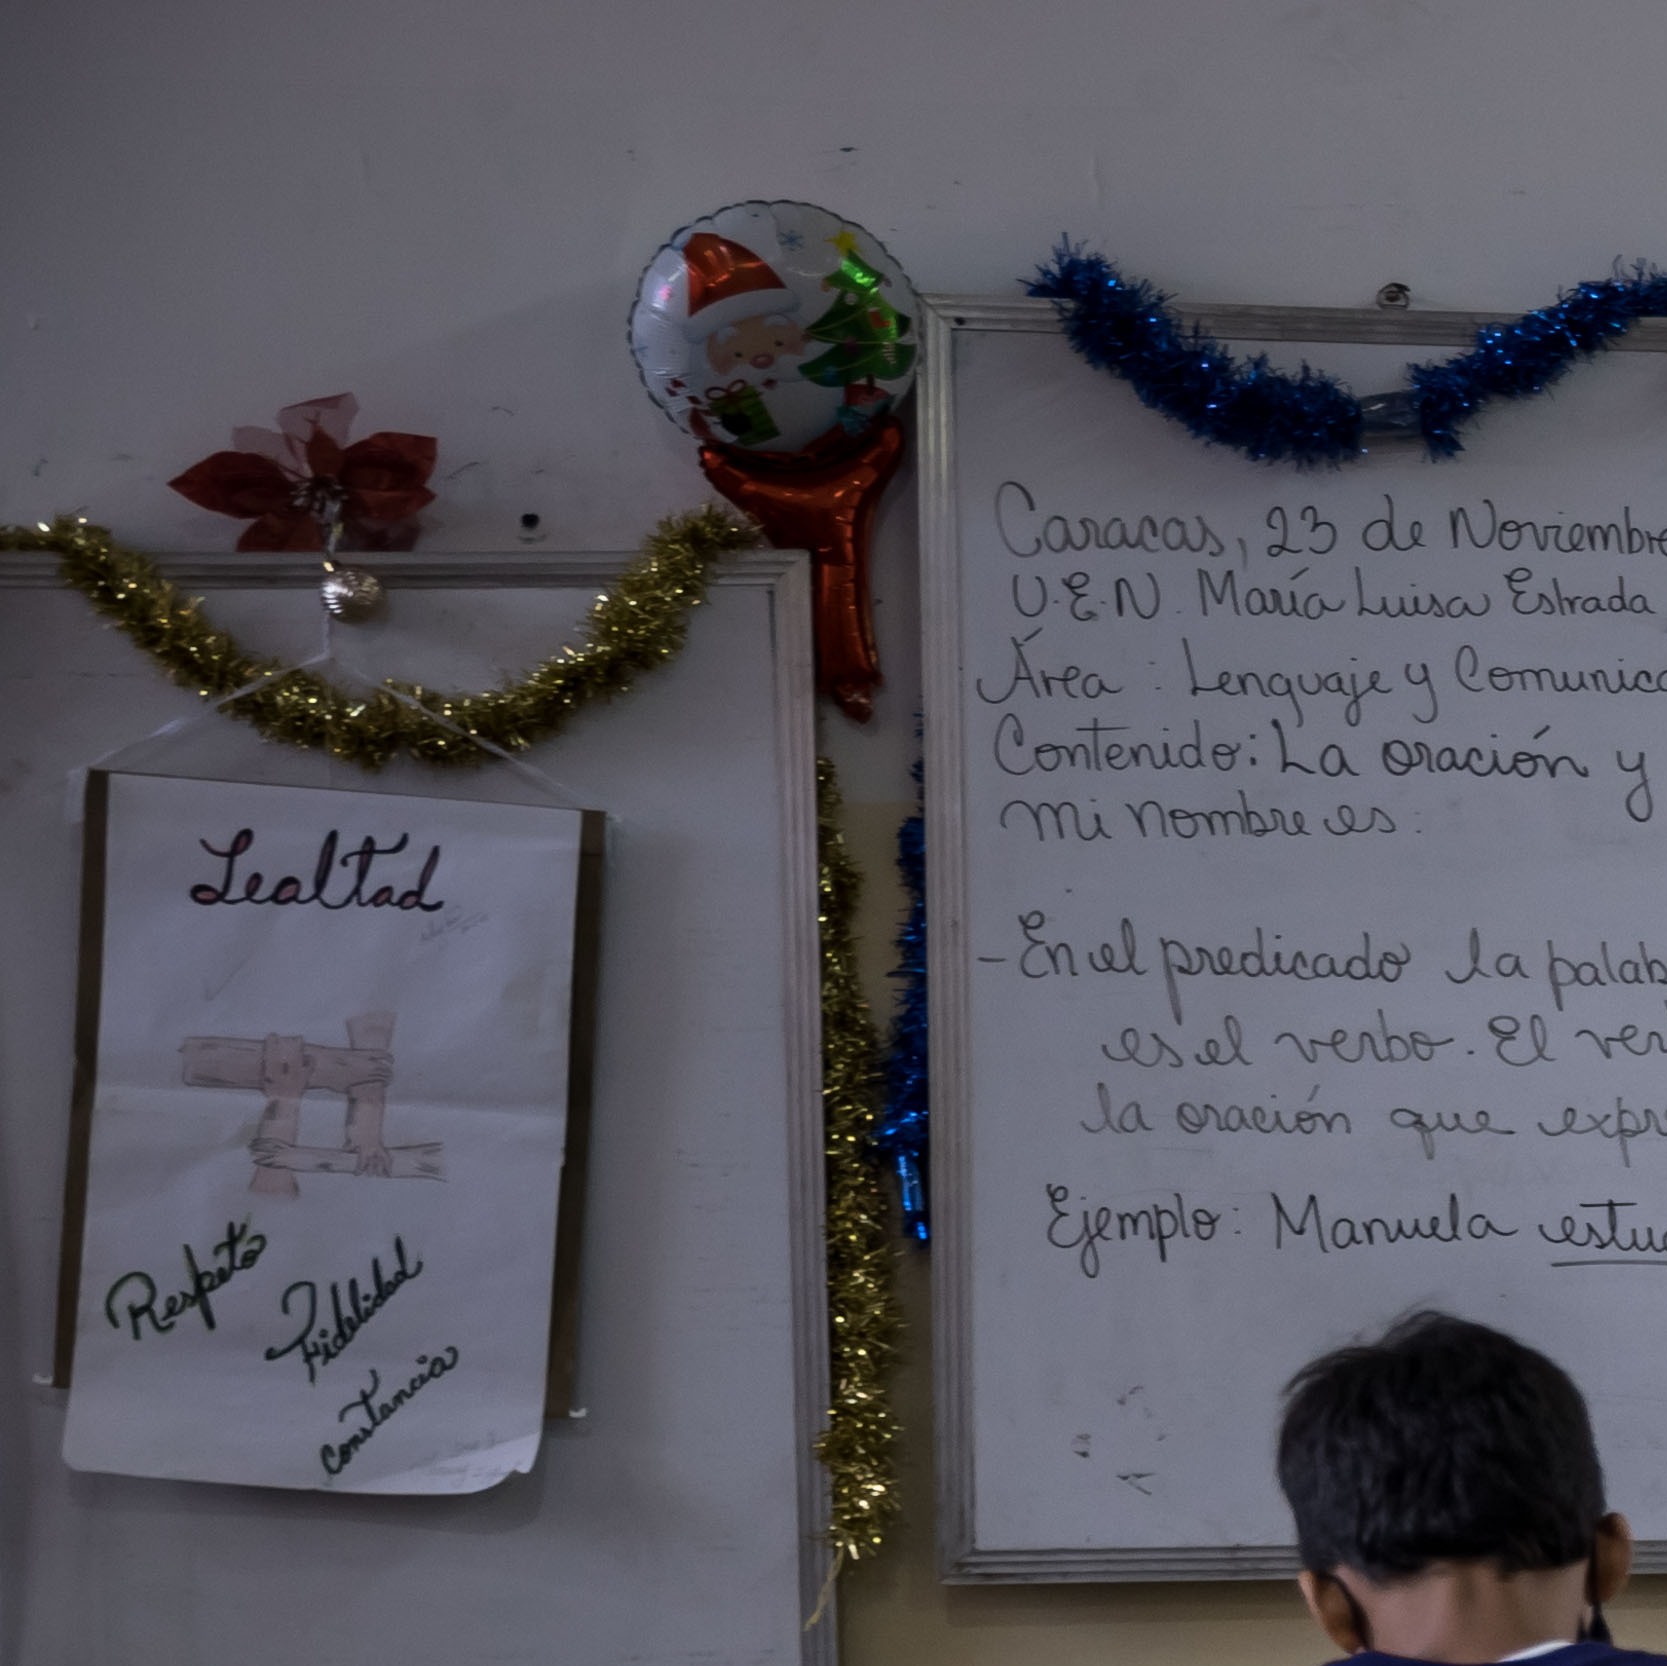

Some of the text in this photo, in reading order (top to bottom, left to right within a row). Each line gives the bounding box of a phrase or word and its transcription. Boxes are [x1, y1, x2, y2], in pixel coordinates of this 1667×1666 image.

[995, 481, 1250, 568] Caracas,
[1264, 503, 1338, 557] 23
[1361, 494, 1428, 551] de
[1197, 567, 1347, 620] María
[1353, 567, 1492, 619] Luisa
[1505, 566, 1656, 618] Estrada
[1181, 637, 1395, 727] Lenguaje
[1403, 660, 1440, 725] y
[994, 712, 1261, 778] Contenido:
[1271, 717, 1361, 778] La
[1382, 724, 1591, 780] oración
[1614, 747, 1655, 823] y
[189, 828, 445, 914] Lealtad
[1089, 917, 1148, 977] el
[1159, 926, 1413, 1026] predicado
[1444, 927, 1531, 985] la
[1101, 1025, 1185, 1069] es
[1196, 1013, 1254, 1067] el
[1487, 1013, 1559, 1067] El
[1080, 1081, 1155, 1136] la
[1175, 1084, 1353, 1137] oración
[1388, 1105, 1518, 1161] que
[1045, 1181, 1243, 1280] Ejemplo:
[1269, 1191, 1521, 1256] Manuela
[104, 1219, 268, 1342] Respeto
